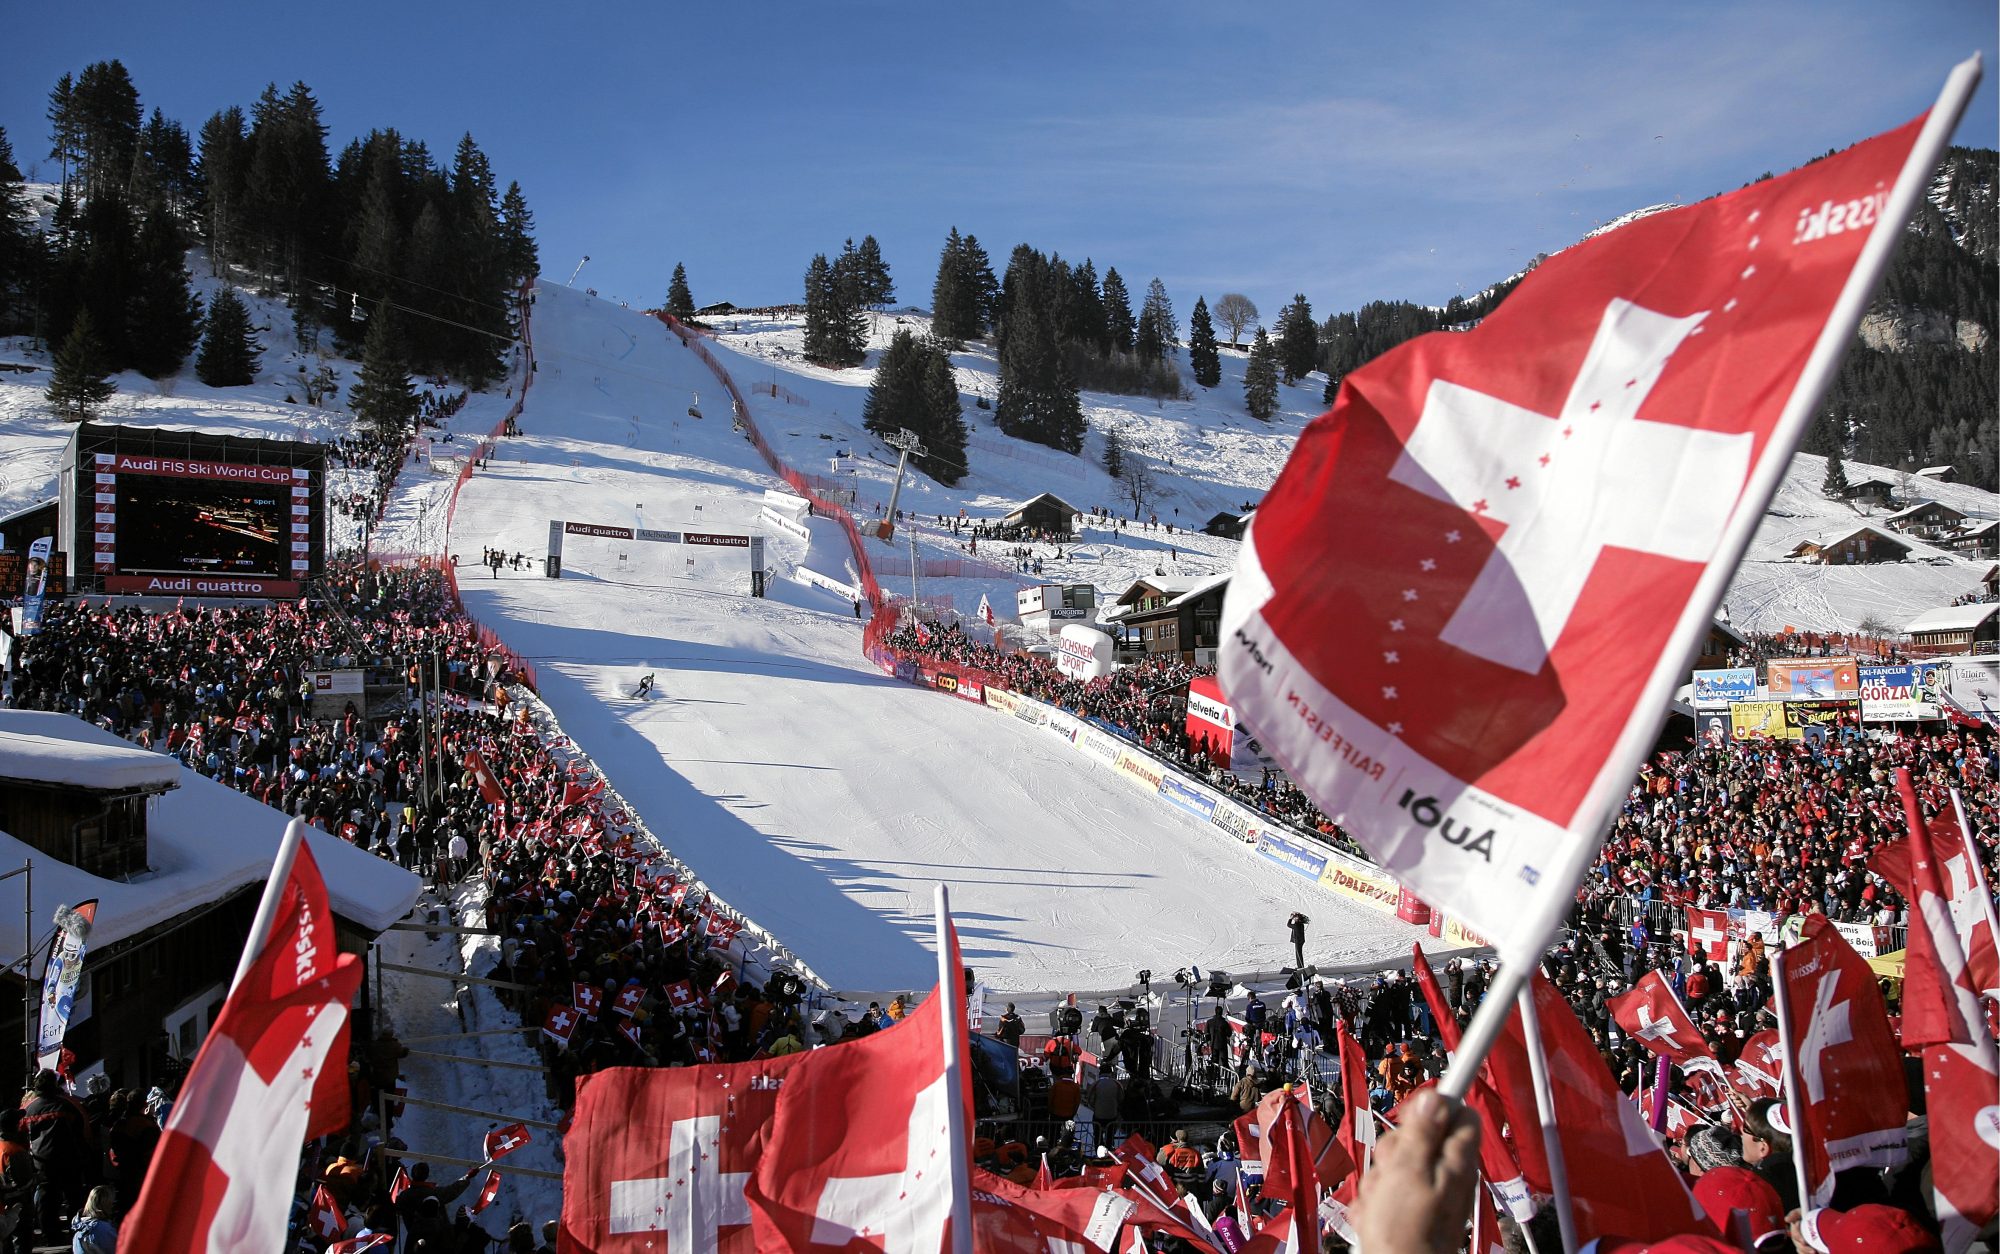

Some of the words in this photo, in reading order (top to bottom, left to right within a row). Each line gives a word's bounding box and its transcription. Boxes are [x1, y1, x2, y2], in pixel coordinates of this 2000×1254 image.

[120, 458, 158, 471] Audi
[162, 461, 185, 473] FIS
[188, 463, 210, 475] Ski
[214, 465, 257, 478] World
[261, 469, 290, 482] Cup
[568, 524, 591, 533] Audi
[593, 527, 629, 538] quattro
[640, 530, 678, 540] Adelboden
[689, 535, 711, 544] Audi
[713, 537, 748, 546] quattro
[149, 578, 191, 590] Audi
[196, 579, 262, 593] quattro
[1060, 637, 1093, 660] OCHSNER
[1062, 654, 1086, 673] SPORT
[1859, 667, 1907, 676] SKI-FANCLUB
[1954, 668, 1986, 681] Valloire
[317, 678, 330, 687] SF
[937, 675, 957, 692] coop
[1860, 675, 1887, 687] ALEŠ
[1697, 689, 1755, 697] SIMONCELLI
[1861, 685, 1909, 701] GORZA
[1188, 697, 1220, 720] helvetia
[1734, 703, 1763, 713] DIDIER
[1808, 710, 1837, 723] Didier
[1049, 718, 1070, 738] helvetia
[1084, 735, 1118, 760] RAIFFEISEN
[1122, 757, 1162, 790] TOBLERONE
[1838, 925, 1859, 934] amis
[1855, 937, 1874, 946] Bois
